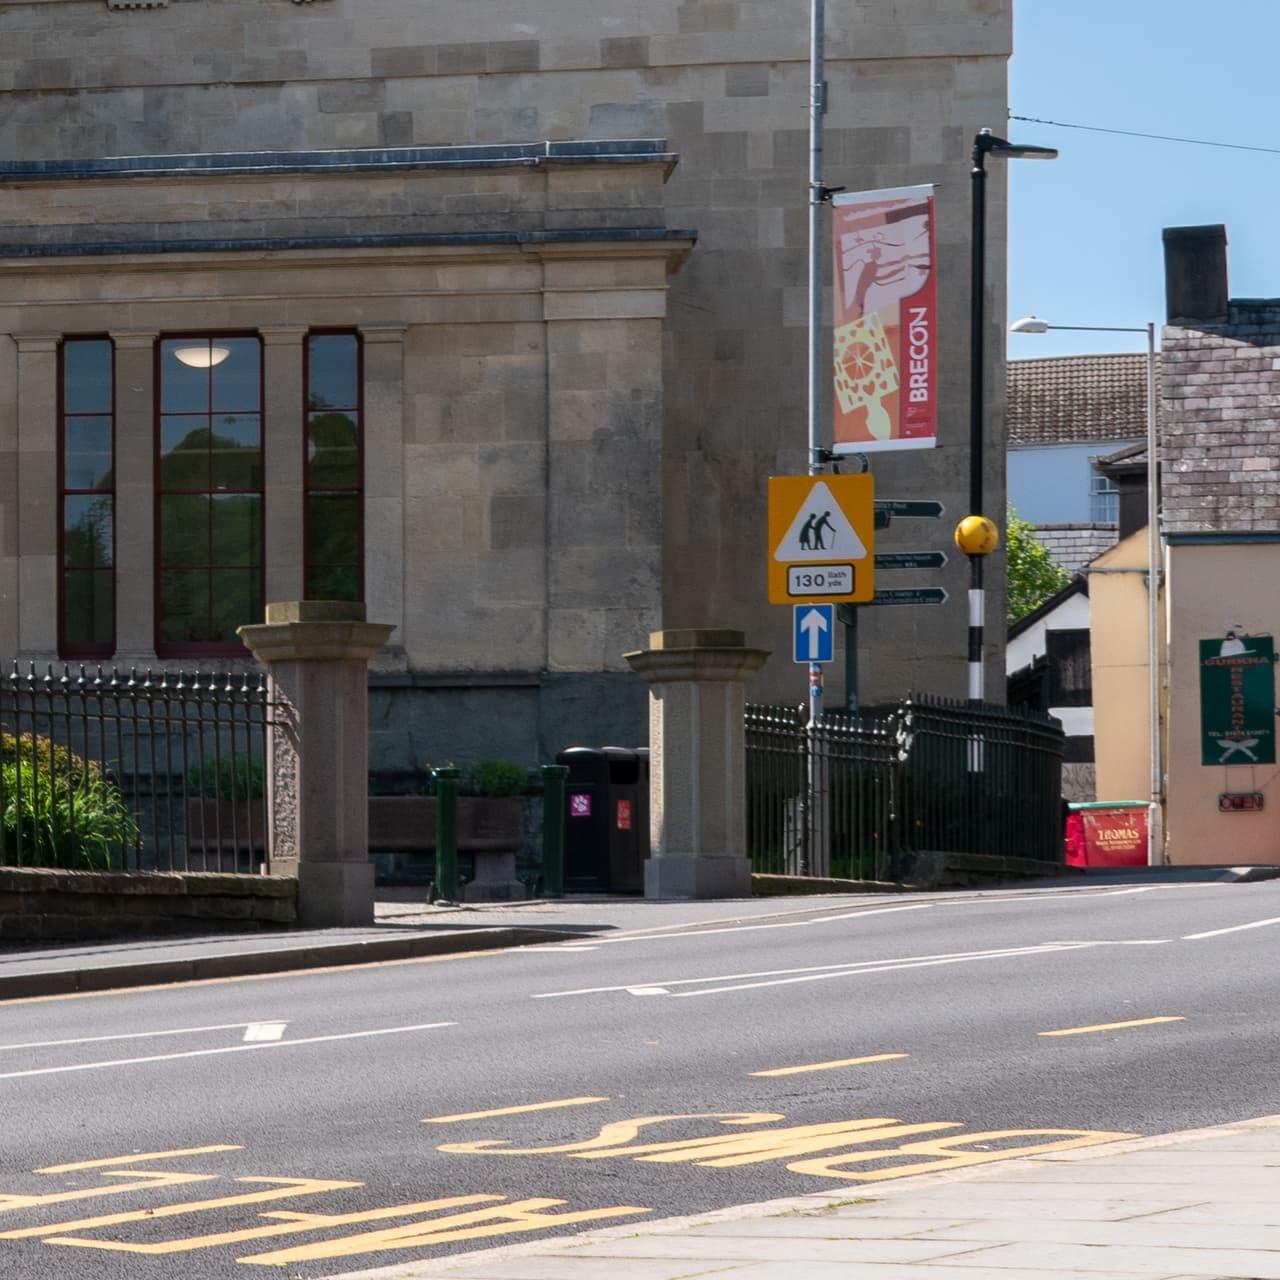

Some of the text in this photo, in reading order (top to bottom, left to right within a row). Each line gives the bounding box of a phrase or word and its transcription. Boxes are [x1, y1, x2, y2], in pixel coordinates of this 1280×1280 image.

[909, 307, 928, 402] BRECON
[795, 574, 825, 587] 130
[1204, 656, 1269, 667] GURKHA
[1097, 828, 1140, 841] THOMAS
